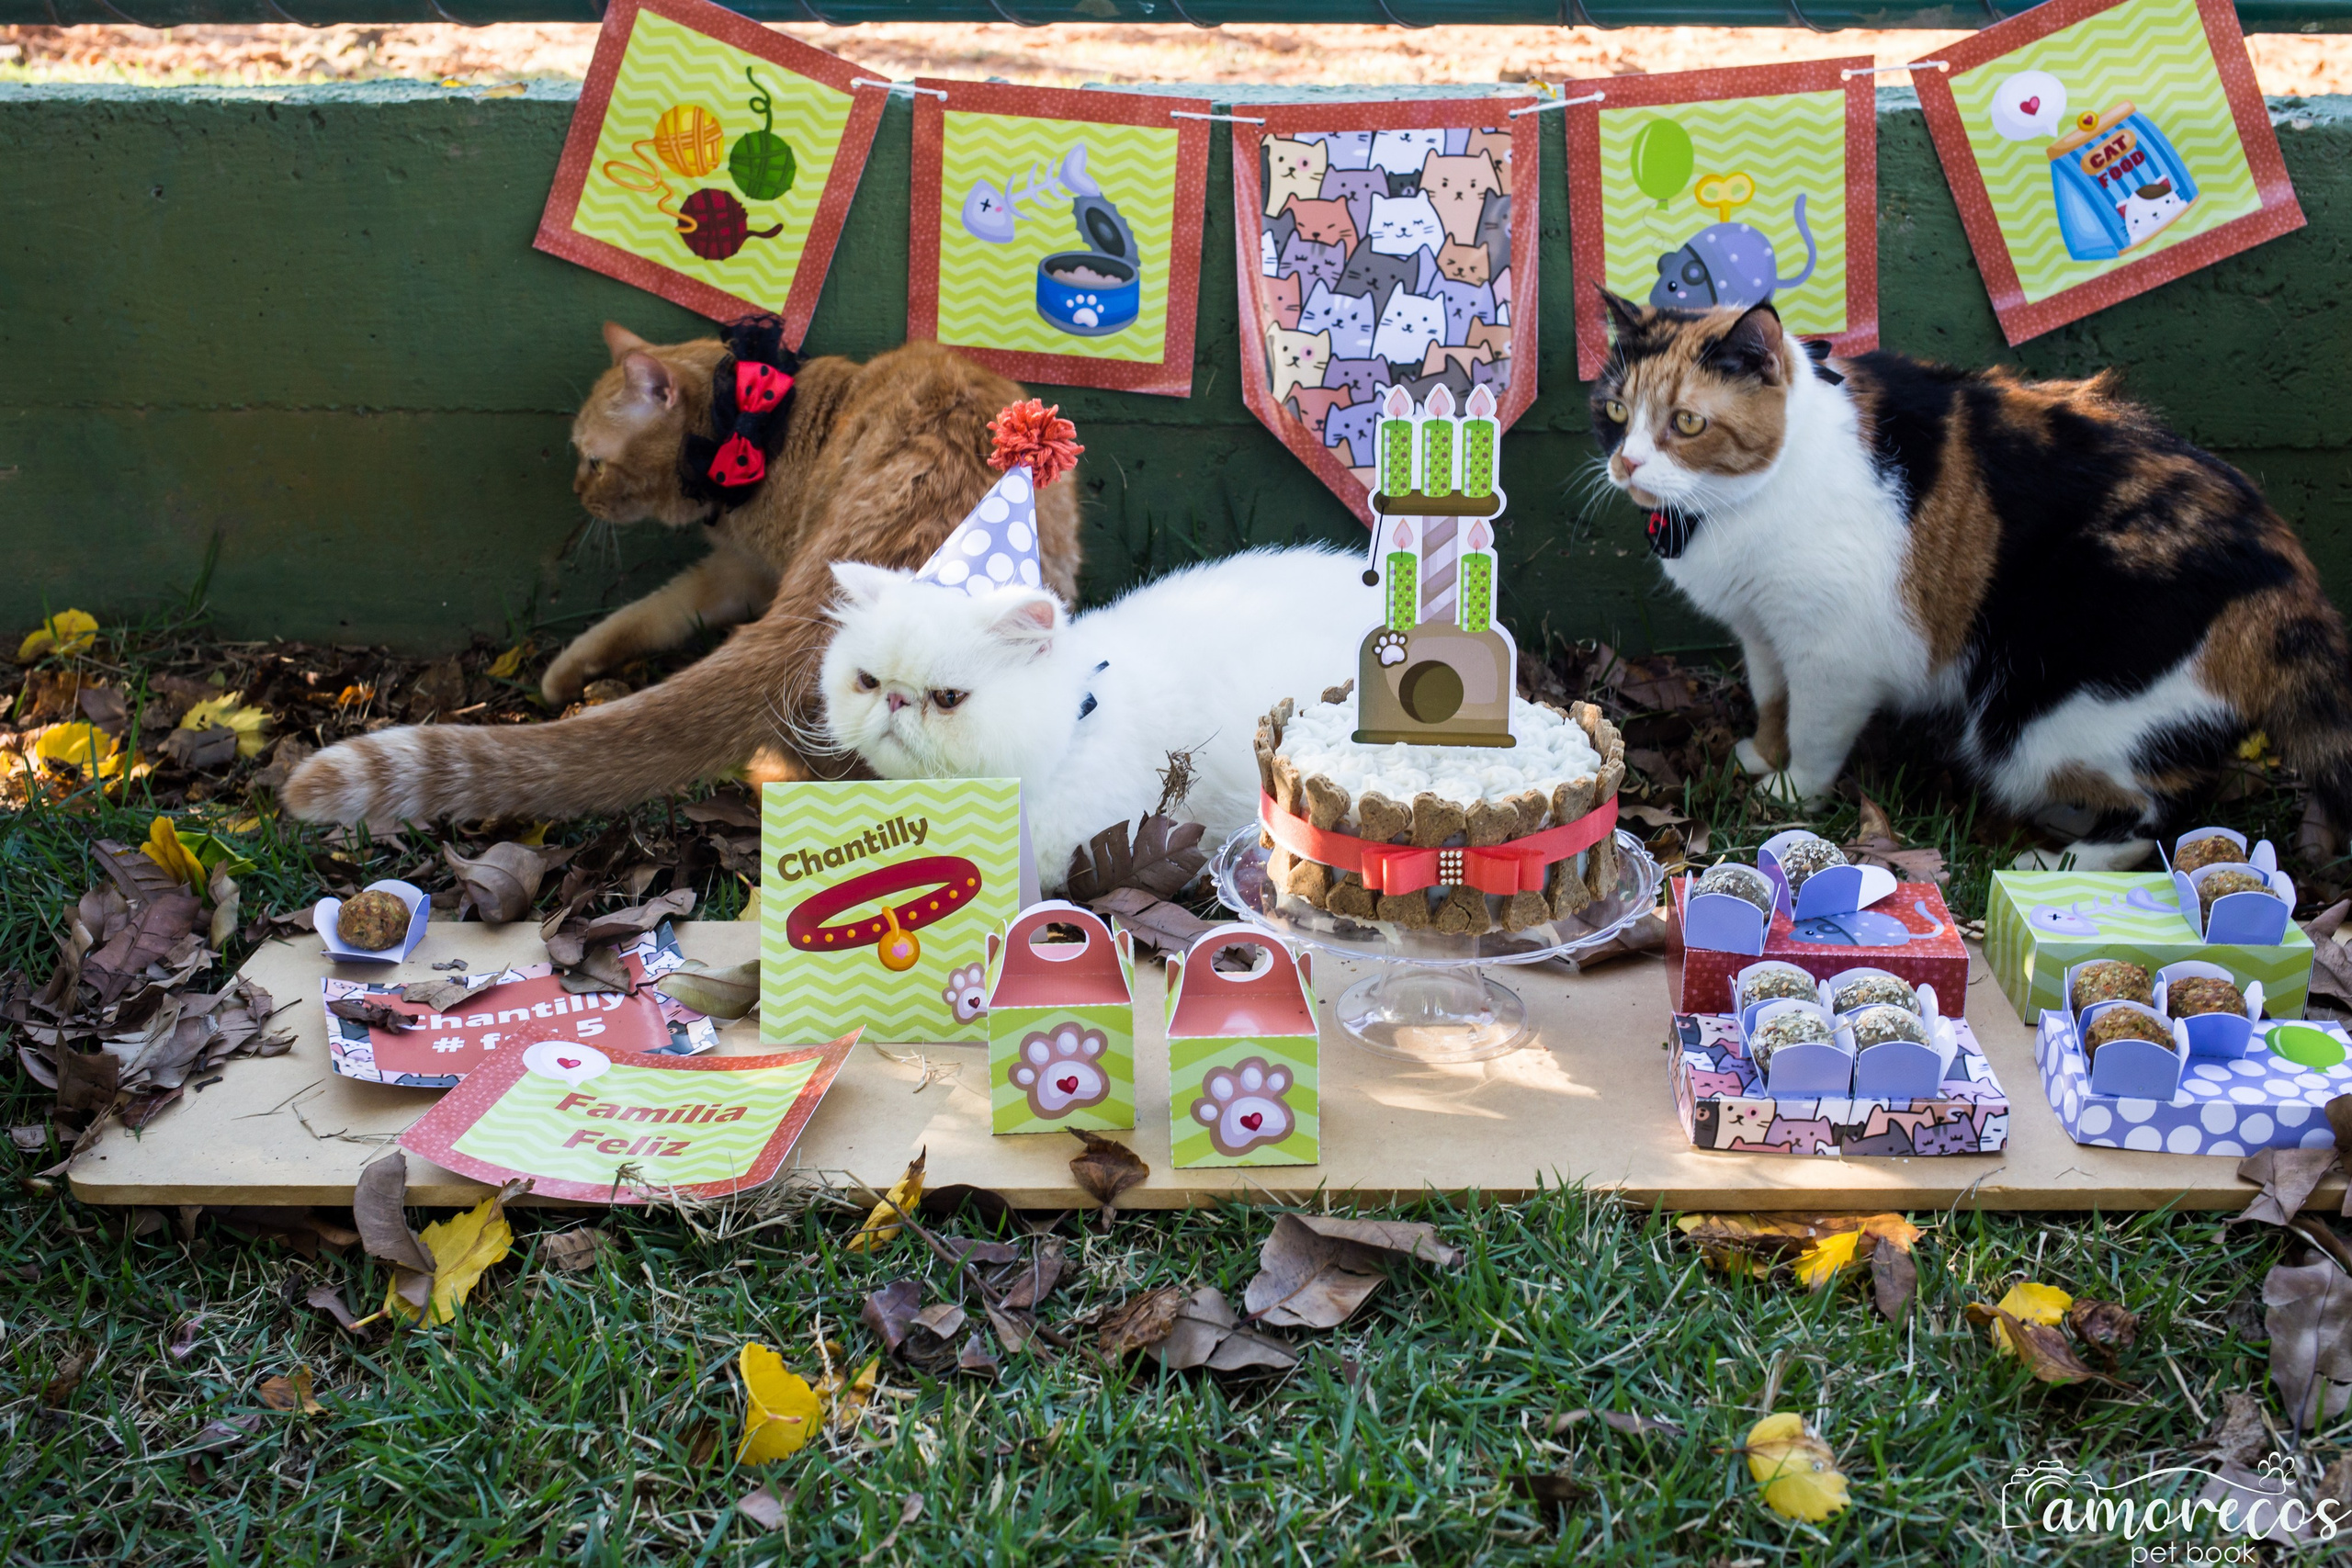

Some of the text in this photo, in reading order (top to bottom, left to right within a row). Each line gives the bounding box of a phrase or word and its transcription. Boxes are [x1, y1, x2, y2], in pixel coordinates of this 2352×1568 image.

[2090, 135, 2128, 169] CAT
[2098, 151, 2145, 189] FOOD
[777, 816, 929, 882] Chantilly
[432, 1036, 466, 1054] #
[576, 1017, 606, 1038] 5
[561, 1129, 692, 1157] Feliz
